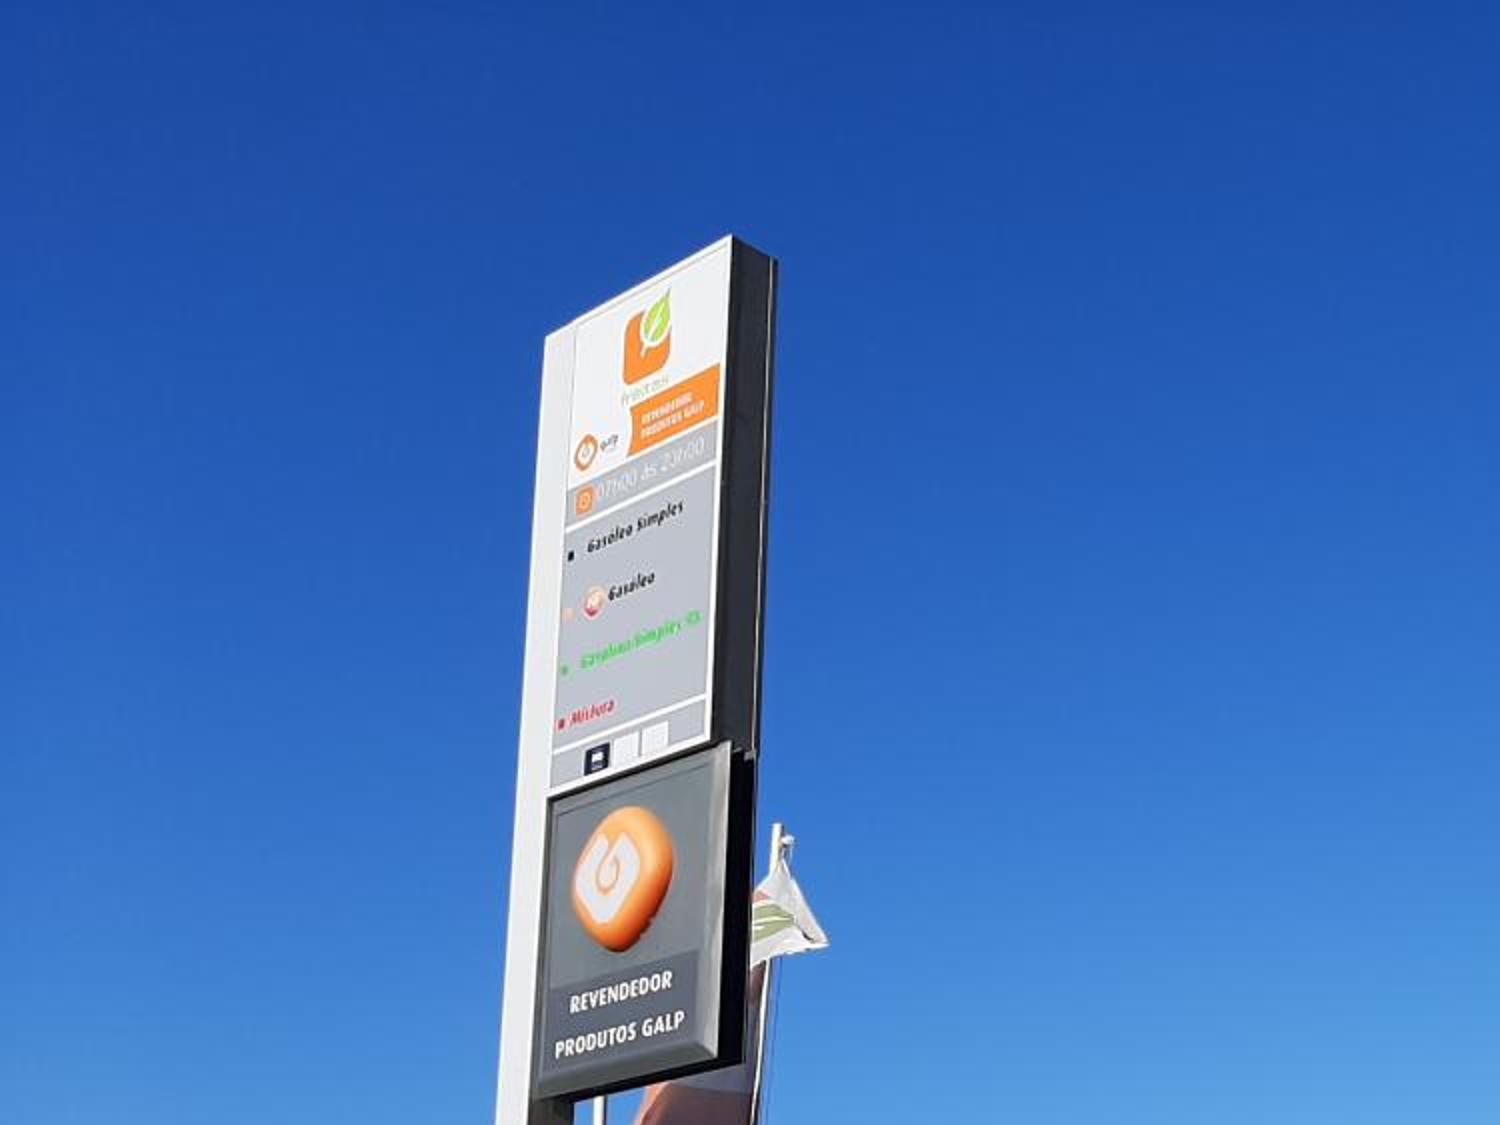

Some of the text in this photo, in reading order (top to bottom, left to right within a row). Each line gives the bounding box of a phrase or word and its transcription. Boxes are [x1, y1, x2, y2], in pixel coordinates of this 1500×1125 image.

[637, 501, 684, 531] Simples
[569, 970, 673, 1014] REVENDEDOR
[555, 1010, 685, 1060] PRODUTOS GALP
